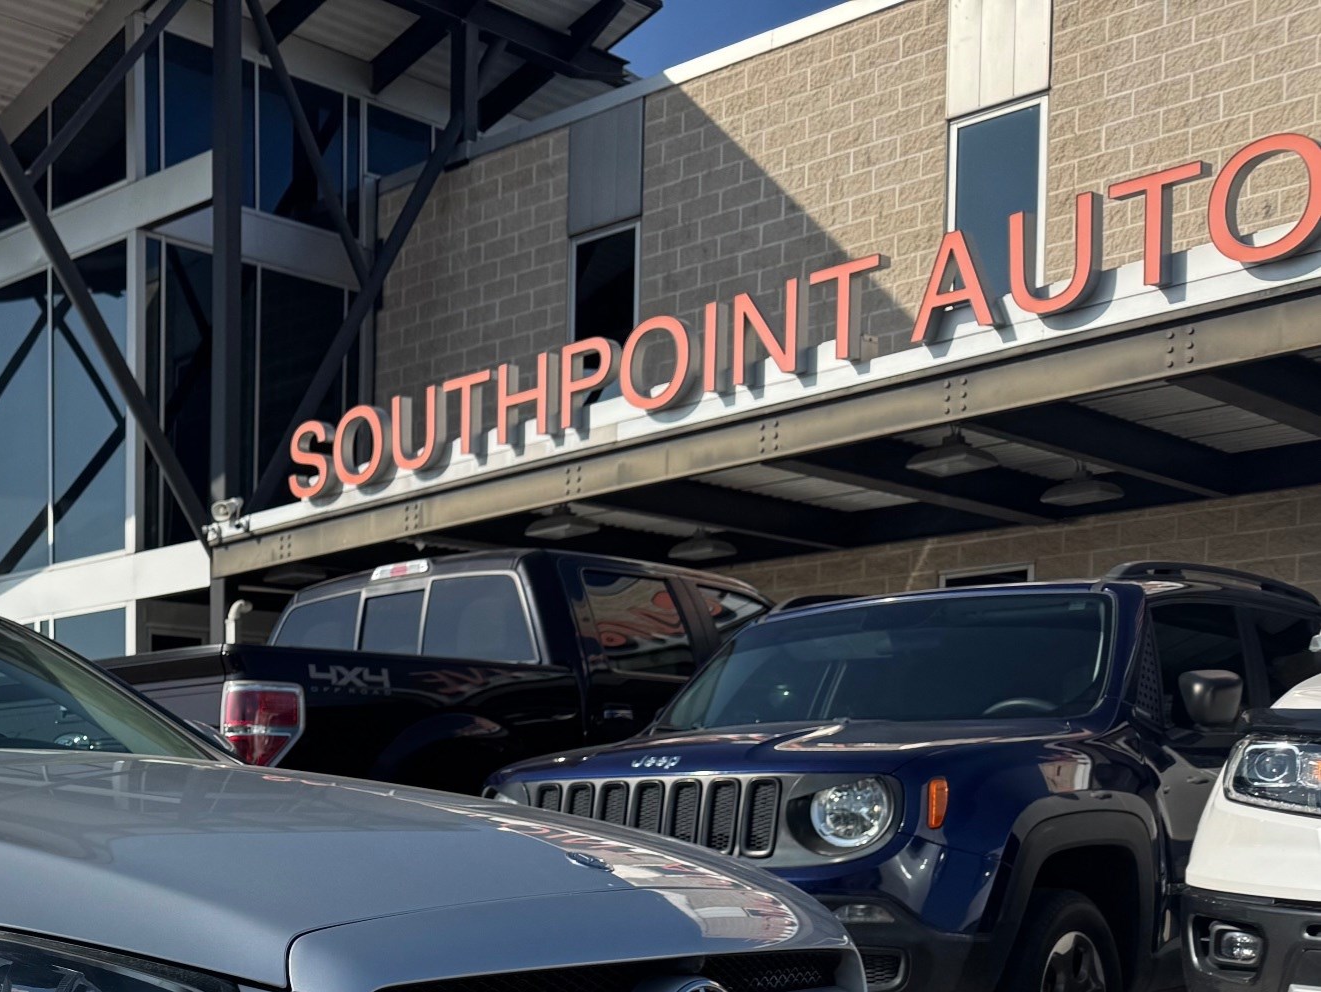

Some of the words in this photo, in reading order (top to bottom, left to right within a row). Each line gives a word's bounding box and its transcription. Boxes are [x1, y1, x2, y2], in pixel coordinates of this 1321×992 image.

[289, 253, 881, 500] SOUTHPOINT
[911, 131, 1321, 343] AUTO
[631, 755, 681, 770] Jeep
